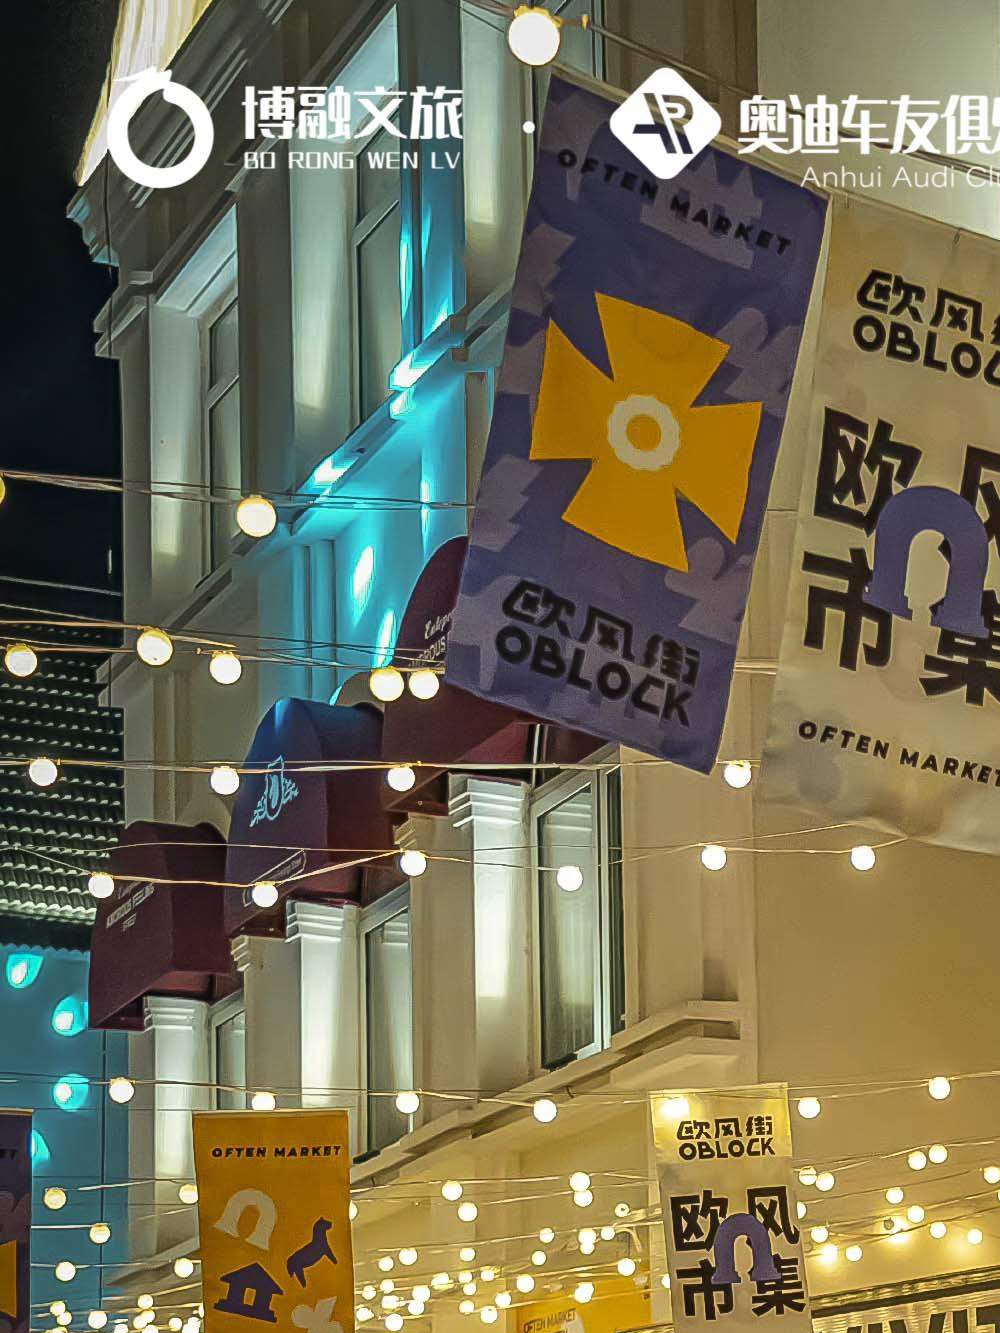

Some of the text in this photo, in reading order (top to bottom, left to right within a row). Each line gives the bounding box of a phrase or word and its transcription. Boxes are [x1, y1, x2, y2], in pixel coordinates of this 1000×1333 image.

[556, 147, 792, 257] OFTEN MARKET
[502, 580, 699, 688] 欧风街
[495, 625, 691, 727] OBLOCK
[798, 720, 890, 761] OFTEN
[211, 1145, 342, 1158] OFTEN MARKET
[677, 1115, 773, 1141] 欧风街
[678, 1138, 776, 1161] OBLOCK
[670, 1186, 800, 1251] 欧风
